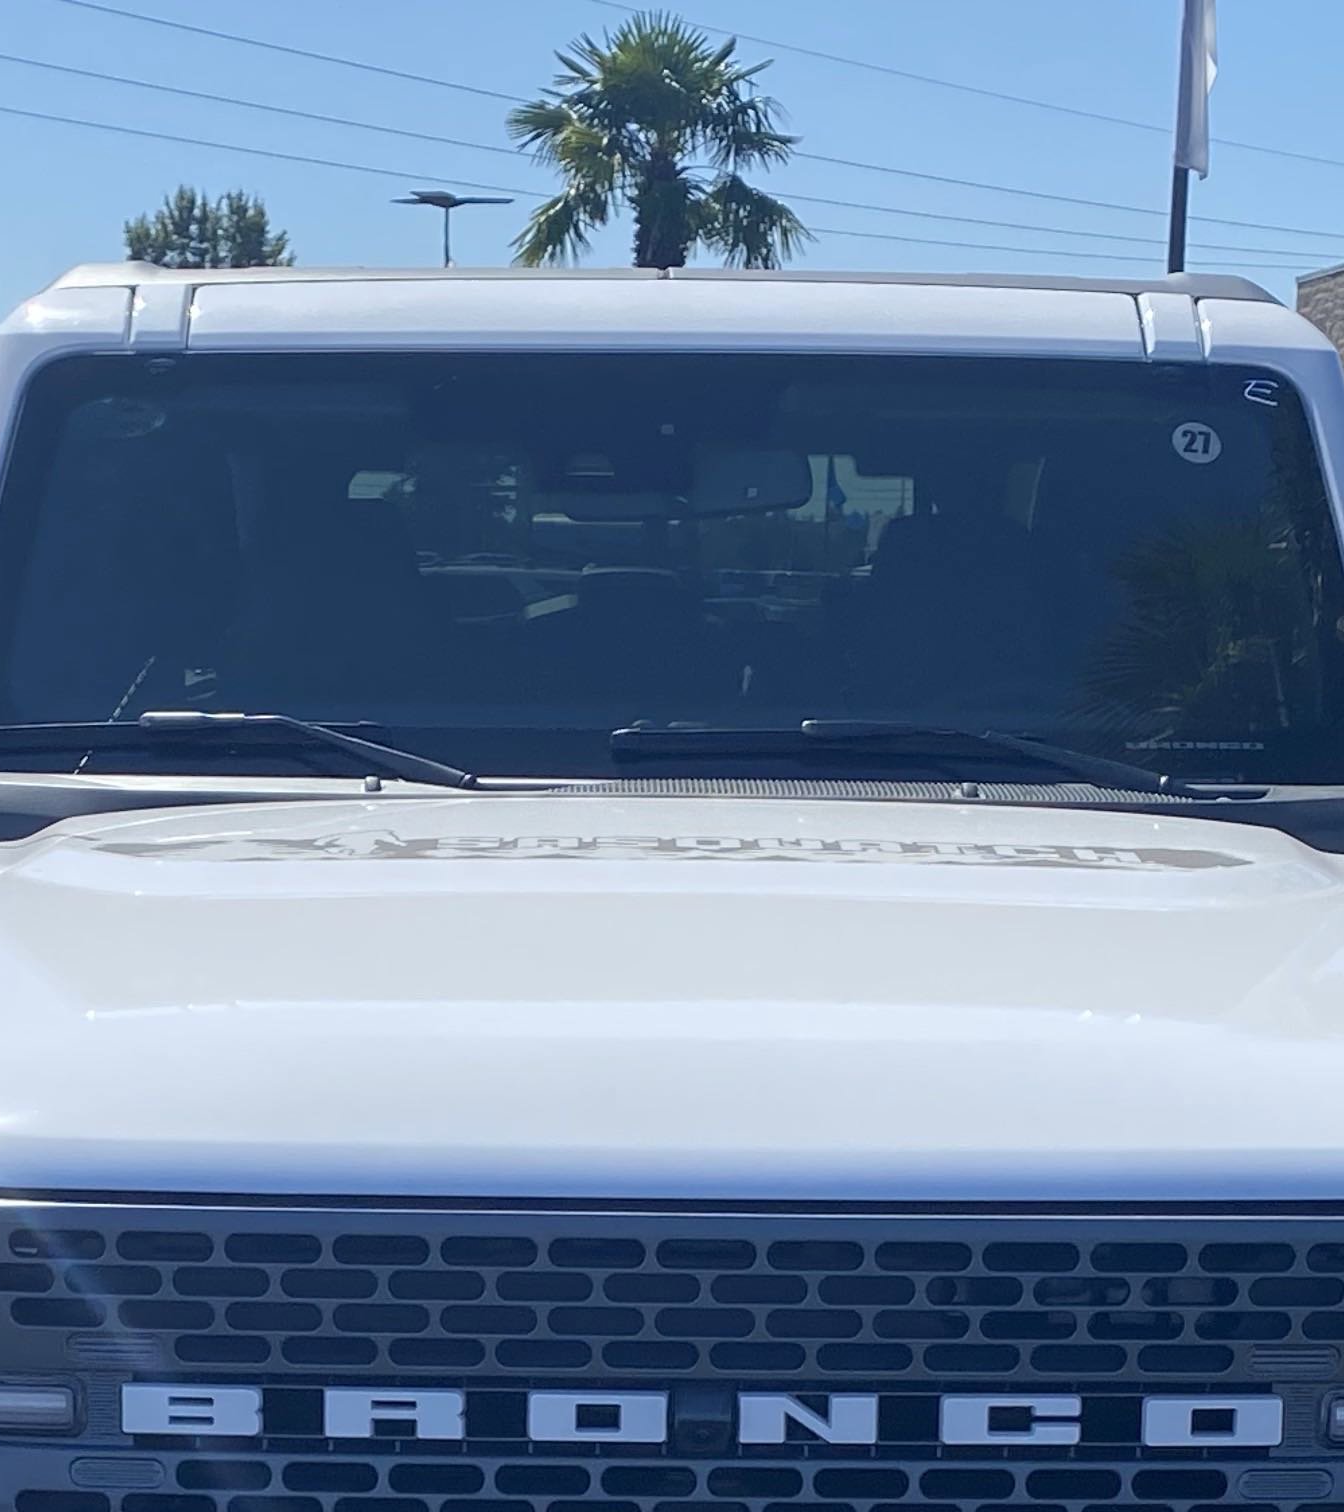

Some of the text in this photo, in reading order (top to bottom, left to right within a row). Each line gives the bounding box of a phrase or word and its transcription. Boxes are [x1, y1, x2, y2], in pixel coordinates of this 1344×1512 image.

[1181, 429, 1211, 454] 27
[434, 836, 1143, 864] SASQUATCH
[122, 1383, 1283, 1446] BRONCO
